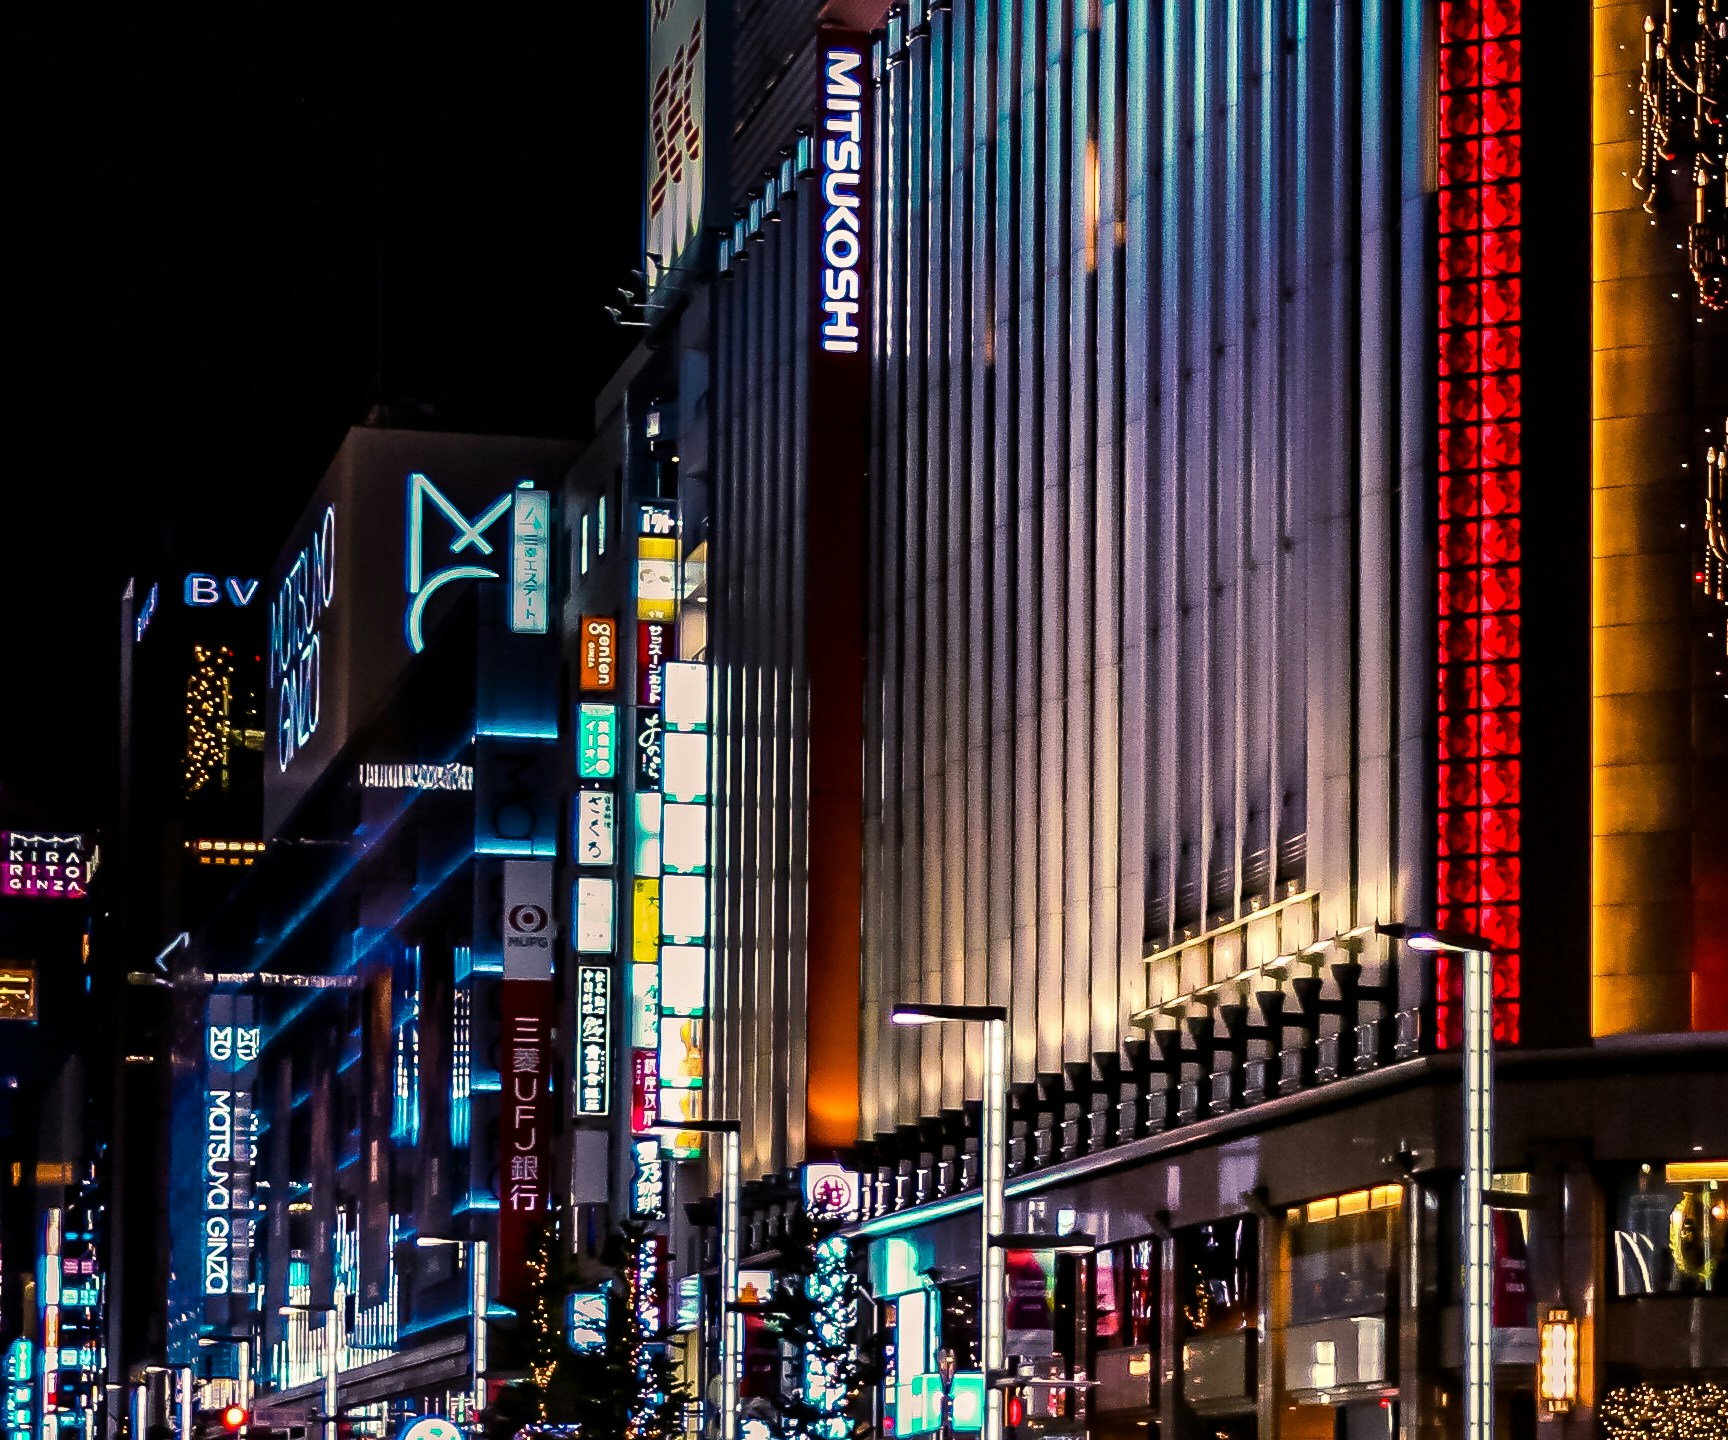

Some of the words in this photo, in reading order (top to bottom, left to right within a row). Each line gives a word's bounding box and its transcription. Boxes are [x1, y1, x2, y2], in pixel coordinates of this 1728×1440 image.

[822, 48, 863, 355] MITSUKOSHI
[588, 622, 613, 685] genten
[583, 720, 597, 774] イーオン
[9, 849, 80, 863] KIRA
[9, 864, 80, 879] RITO
[9, 878, 82, 892] GINZA
[507, 936, 549, 949] MUFG
[510, 1017, 542, 1212] 三菱UFJ銀行
